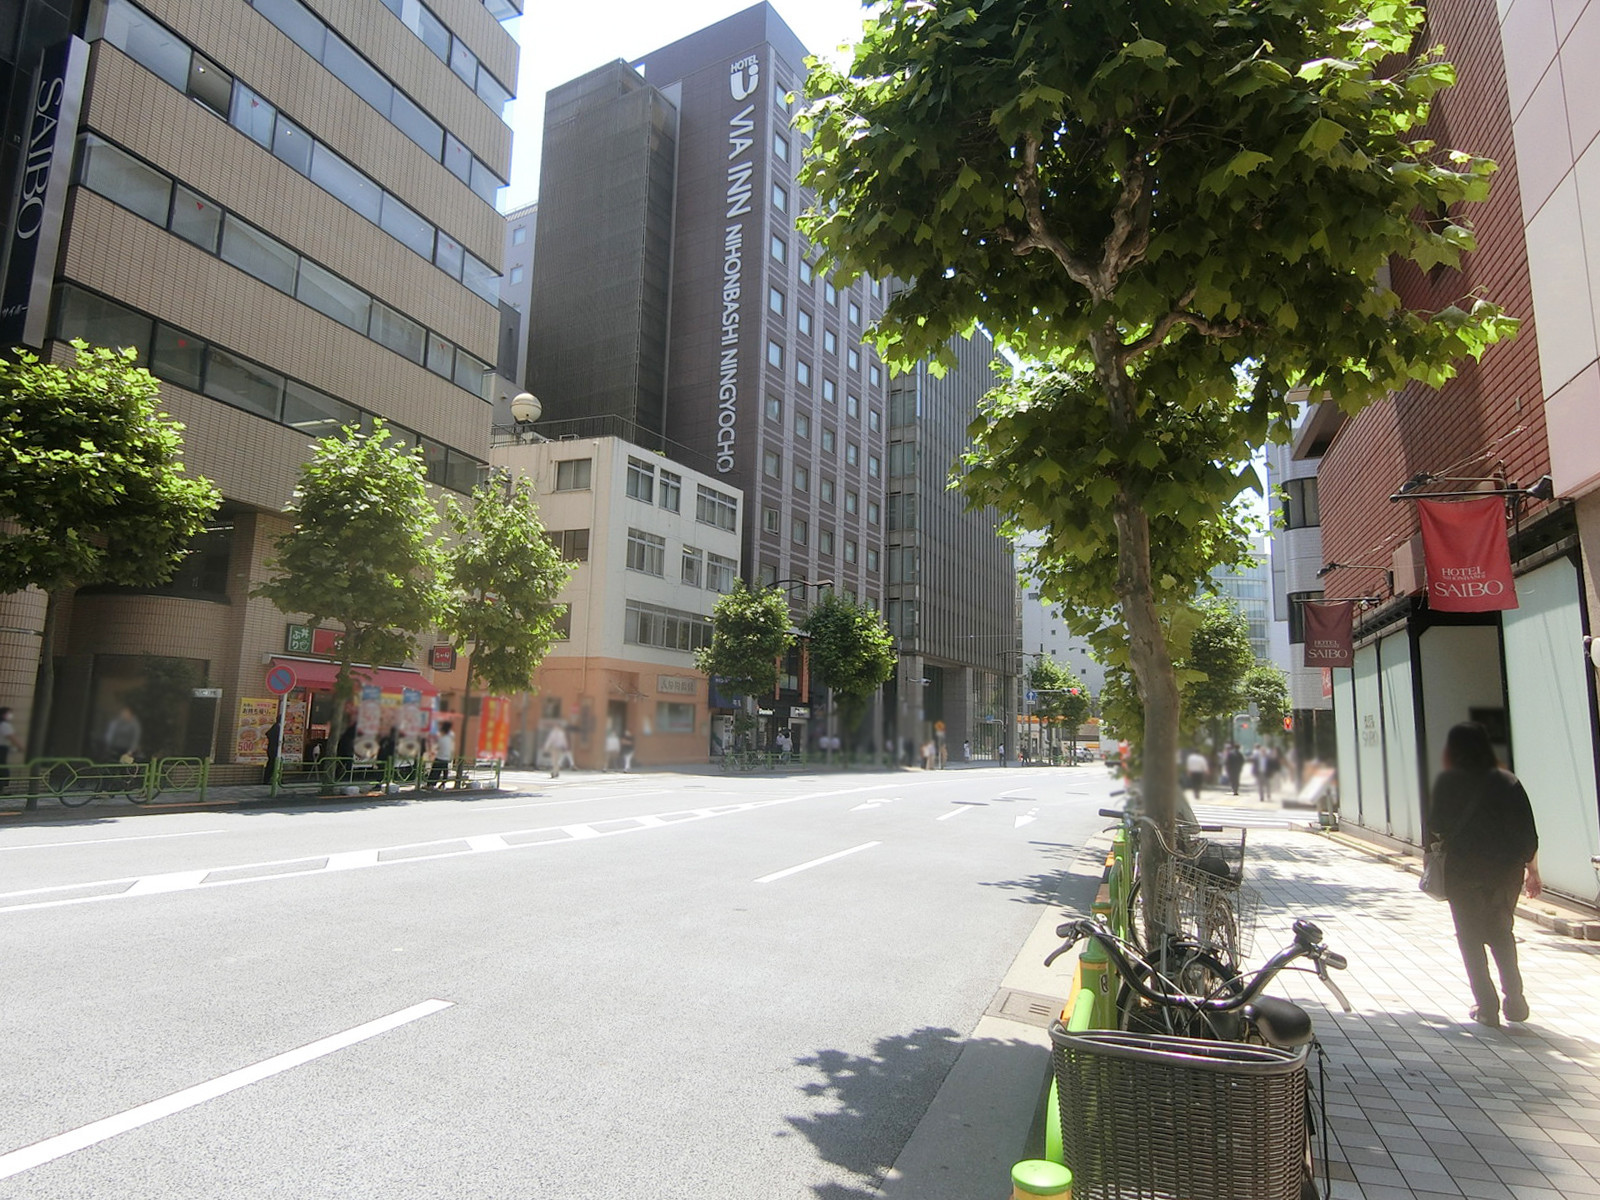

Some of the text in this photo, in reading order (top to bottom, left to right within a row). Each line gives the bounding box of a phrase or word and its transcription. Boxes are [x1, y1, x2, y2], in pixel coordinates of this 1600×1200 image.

[730, 54, 759, 74] HOTEL
[17, 77, 65, 239] SAIBO
[716, 104, 755, 473] VIA INN NIHONBASHI NINGYOCHO
[1441, 566, 1484, 576] HOTEL
[1434, 580, 1504, 598] SAIBO
[1308, 649, 1348, 659] SAIBO
